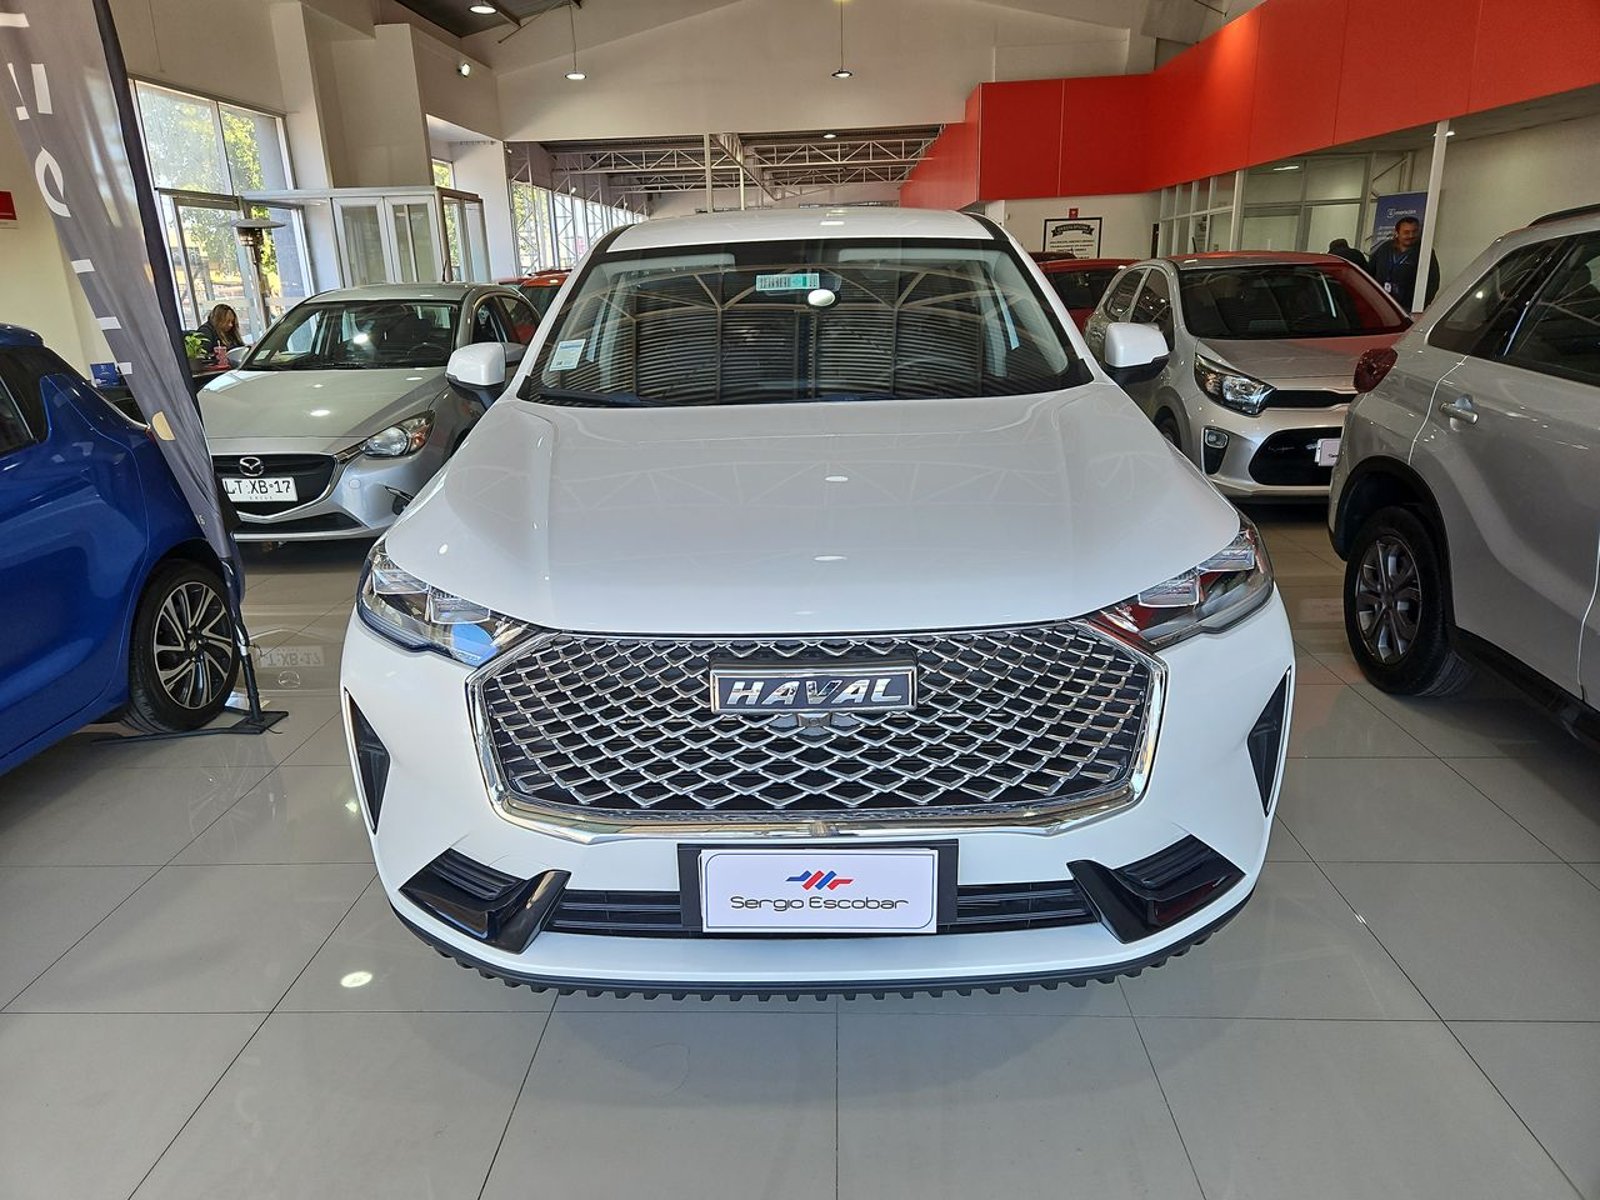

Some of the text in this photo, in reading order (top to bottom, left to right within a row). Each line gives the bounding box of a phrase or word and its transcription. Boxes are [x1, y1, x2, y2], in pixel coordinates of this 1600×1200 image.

[726, 678, 902, 705] HAVAL
[730, 896, 909, 912] Sergio Escobar
